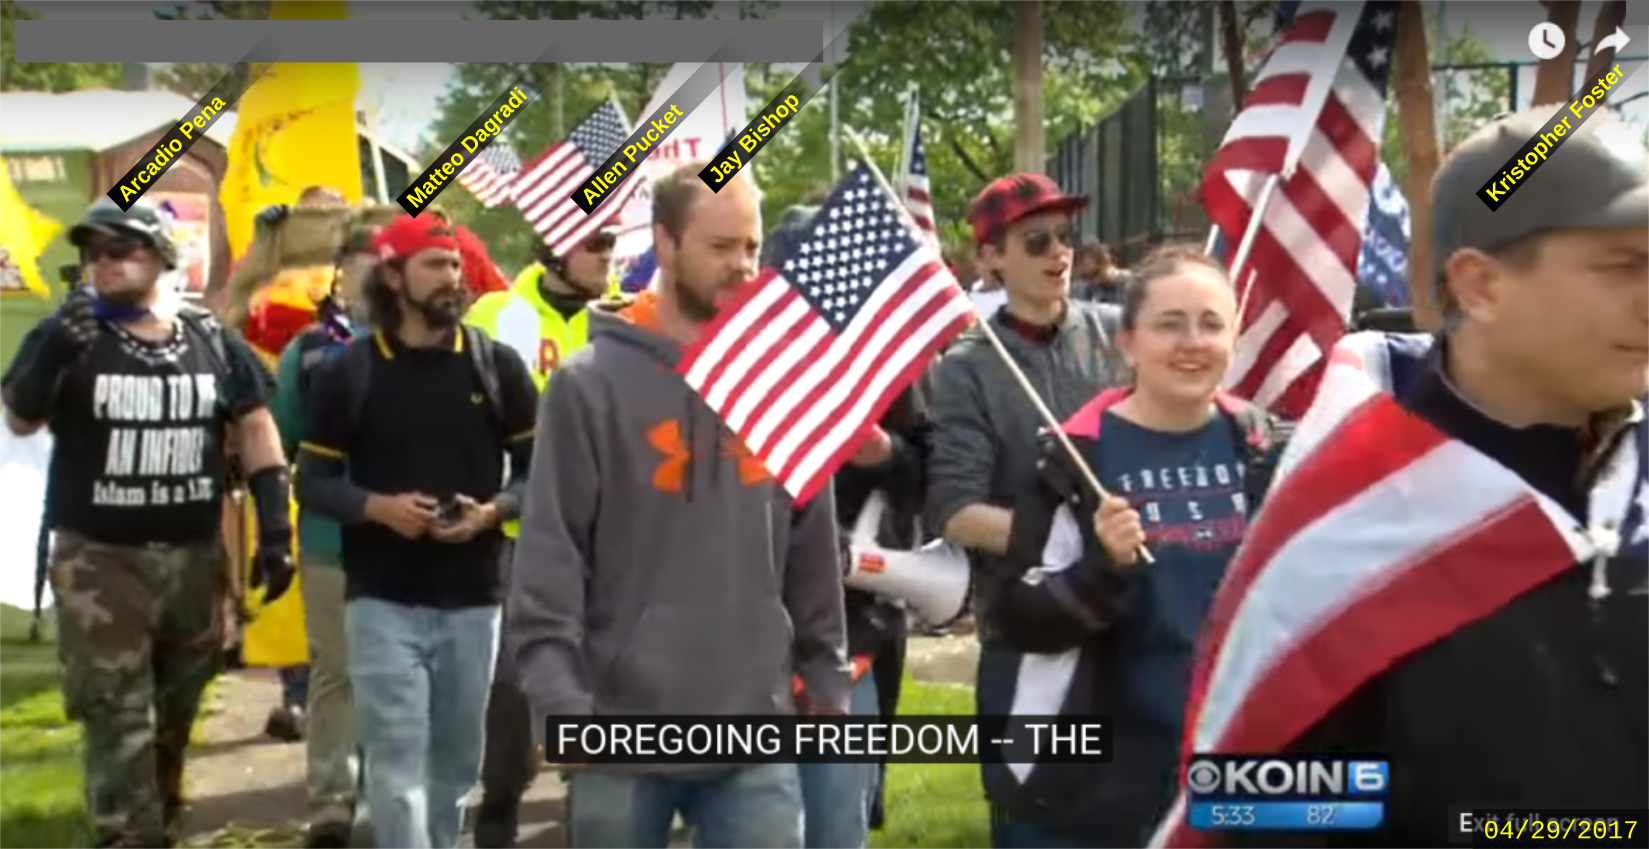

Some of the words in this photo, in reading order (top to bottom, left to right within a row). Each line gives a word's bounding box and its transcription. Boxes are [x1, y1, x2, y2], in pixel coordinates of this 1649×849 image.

[93, 373, 164, 421] PROUD
[166, 373, 192, 421] TO
[104, 428, 137, 475] AN
[138, 427, 205, 475] INFIDE
[93, 480, 146, 505] Islam
[150, 480, 169, 504] is
[173, 485, 185, 503] a
